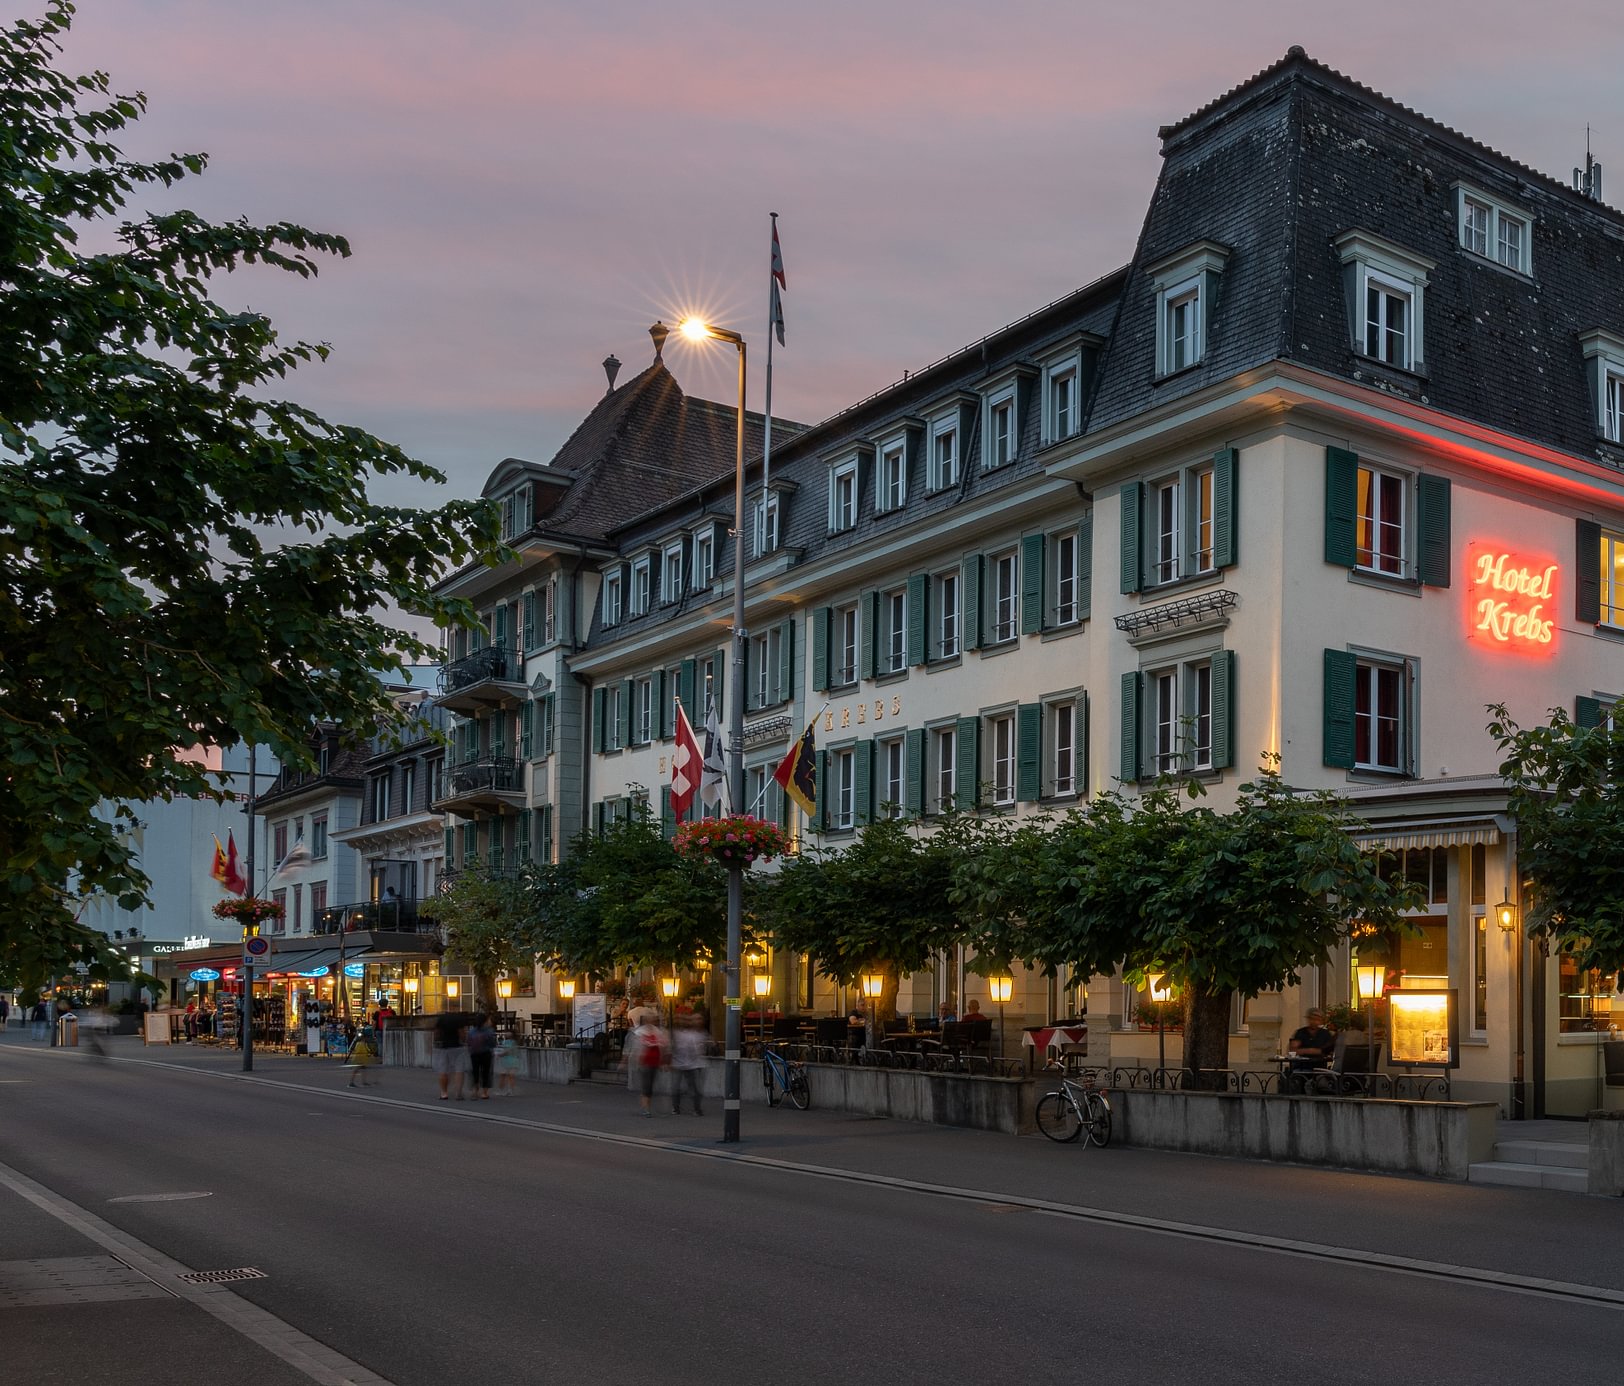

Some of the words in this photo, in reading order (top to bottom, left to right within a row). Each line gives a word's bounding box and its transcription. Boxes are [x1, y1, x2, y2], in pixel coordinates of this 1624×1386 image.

[1475, 554, 1557, 598] Hotel
[1477, 599, 1553, 643] Krebs
[824, 694, 901, 732] KREBS
